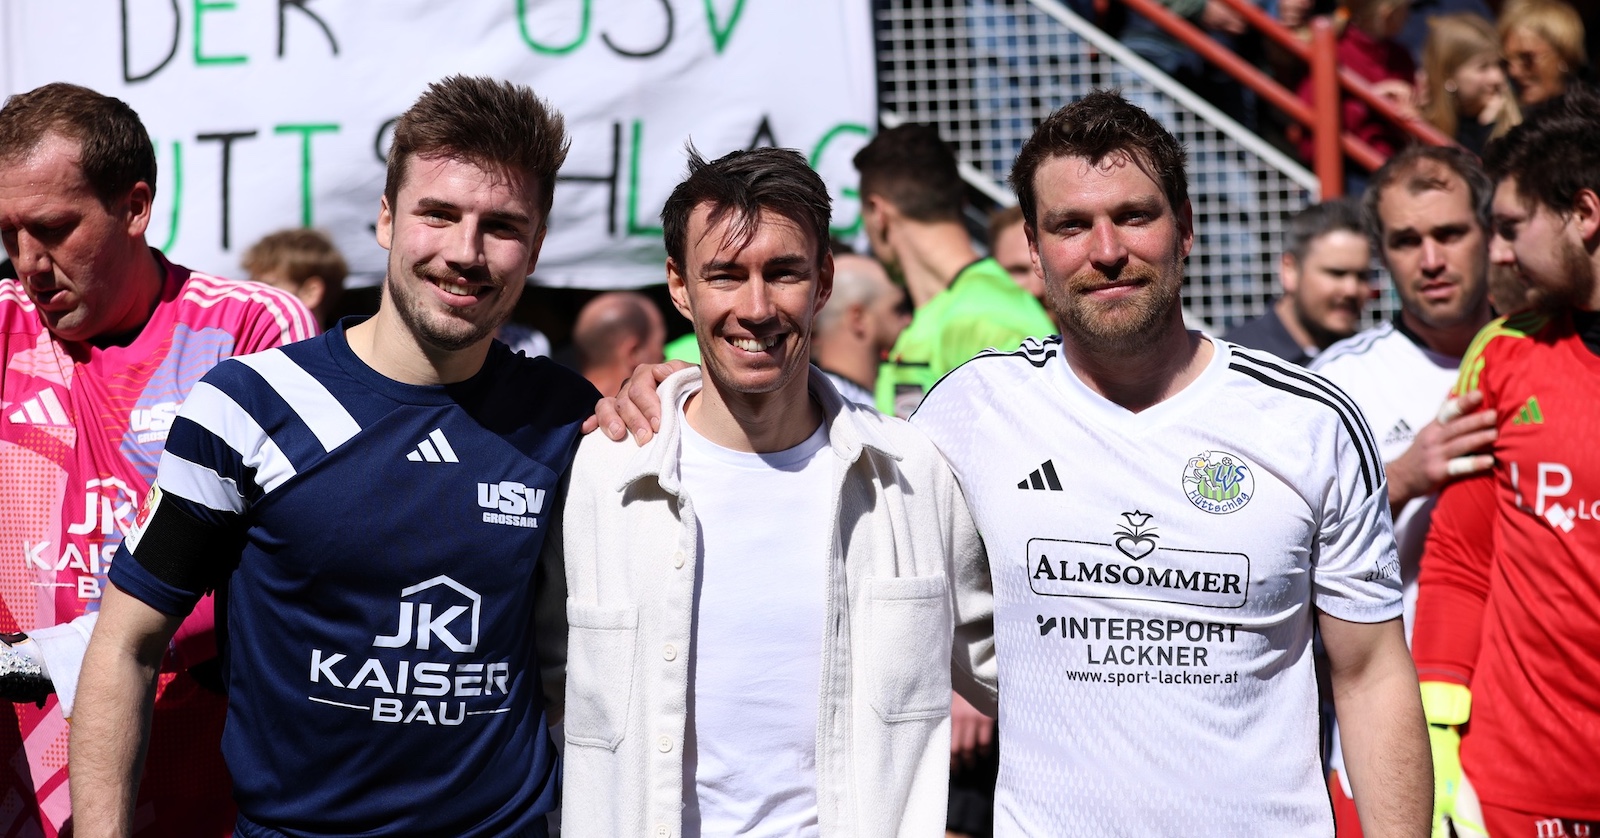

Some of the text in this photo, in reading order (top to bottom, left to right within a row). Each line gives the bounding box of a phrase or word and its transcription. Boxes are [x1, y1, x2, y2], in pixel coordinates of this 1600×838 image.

[477, 481, 546, 515] USV
[1188, 489, 1250, 512] Hüttschlag
[482, 512, 538, 528] GROSSARL
[1033, 554, 1241, 594] ALMSOMMER
[372, 602, 478, 652] JK
[1060, 616, 1242, 643] INTERSPORT
[1087, 645, 1208, 667] LACKNER
[309, 648, 510, 697] KAISER
[1066, 669, 1239, 687] www.sport-lackner.at
[372, 698, 466, 726] BAU
